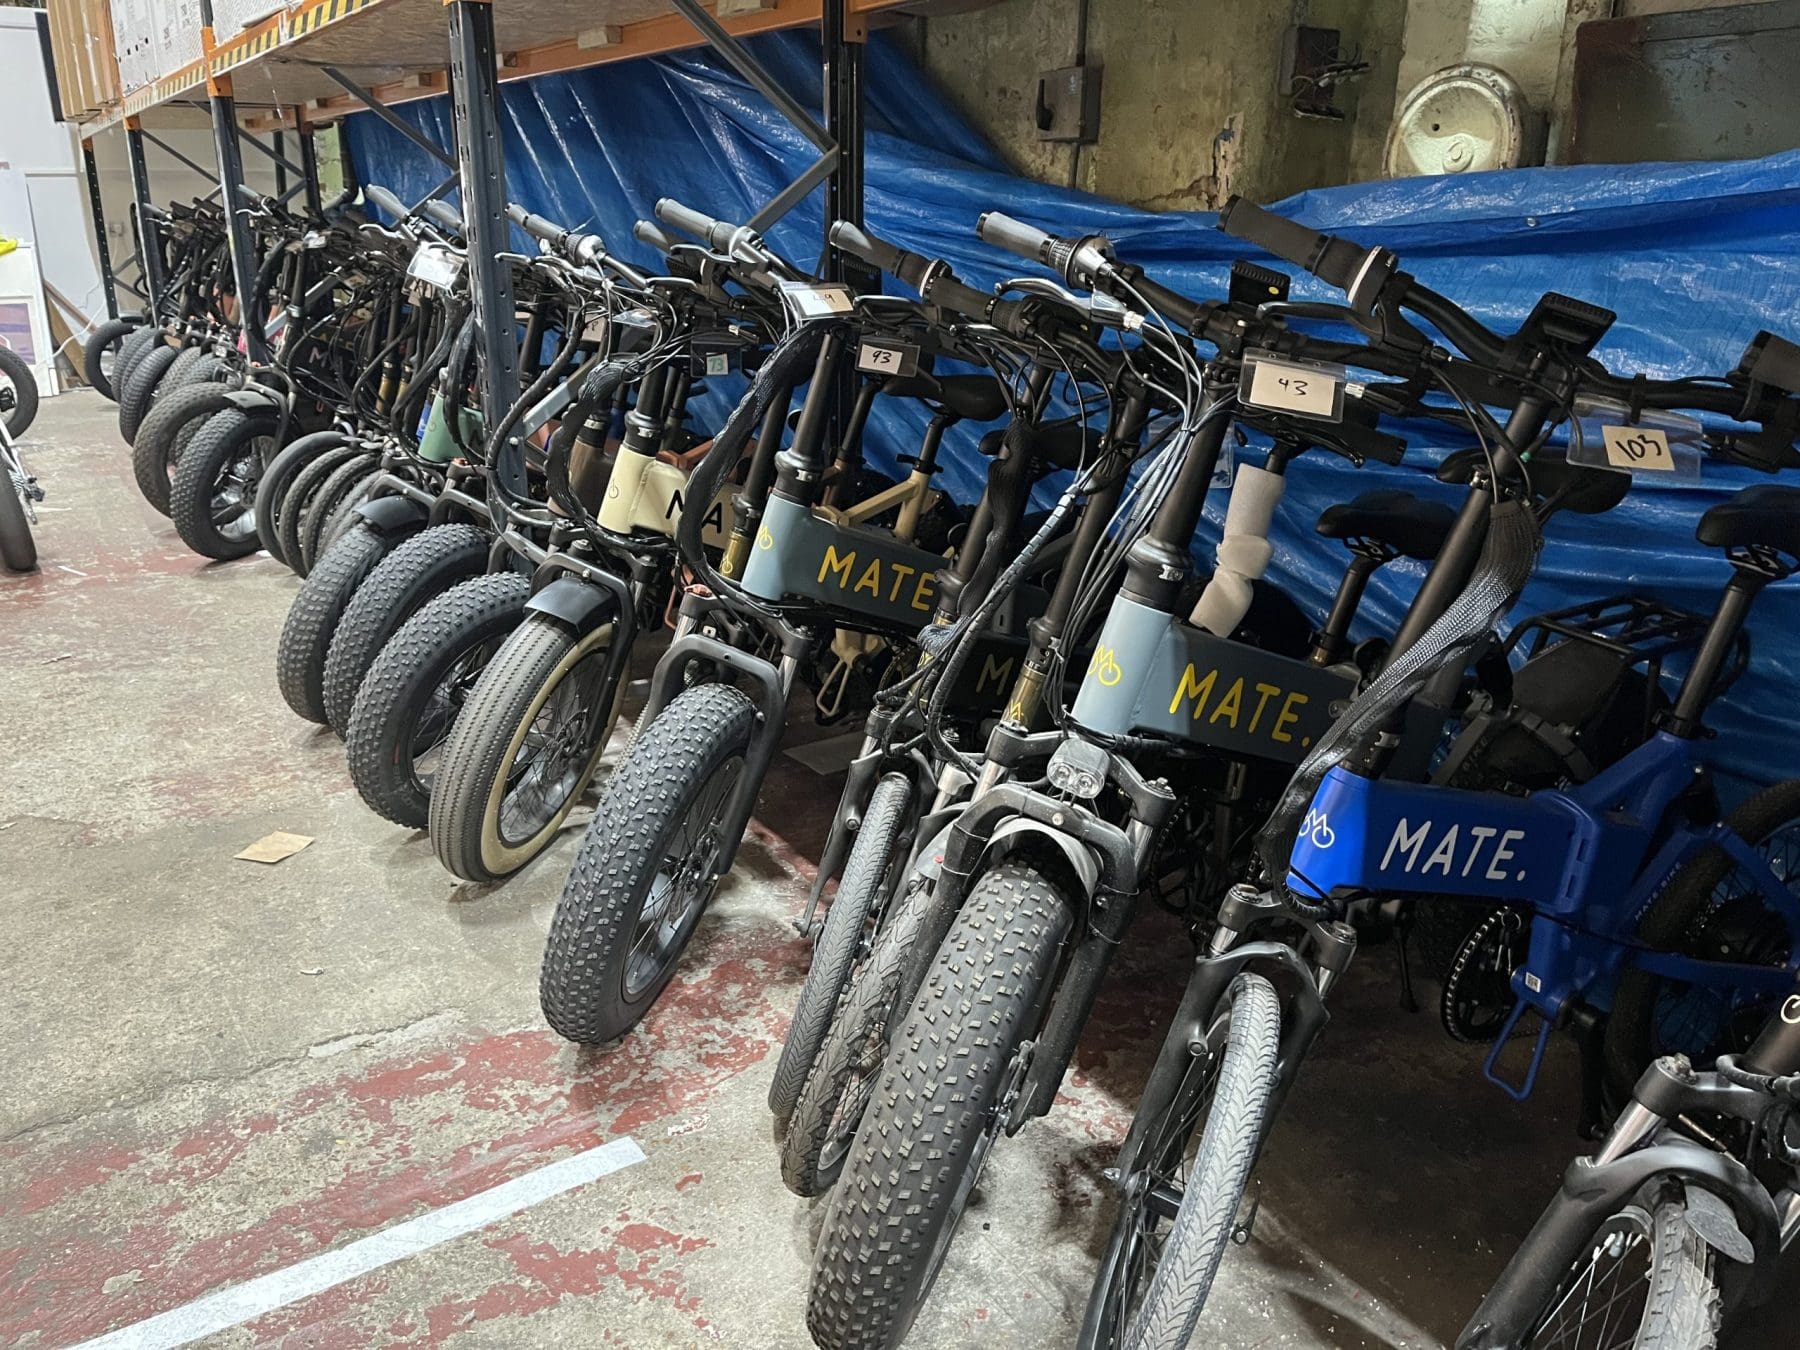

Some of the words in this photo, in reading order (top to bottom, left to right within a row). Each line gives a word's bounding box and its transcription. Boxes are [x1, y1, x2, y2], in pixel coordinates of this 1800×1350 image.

[708, 357, 724, 372] 73
[872, 350, 892, 364] 93
[1277, 376, 1309, 397] 43
[1615, 433, 1664, 462] 103
[1168, 661, 1312, 747] MATE.
[1378, 818, 1527, 882] MATE.
